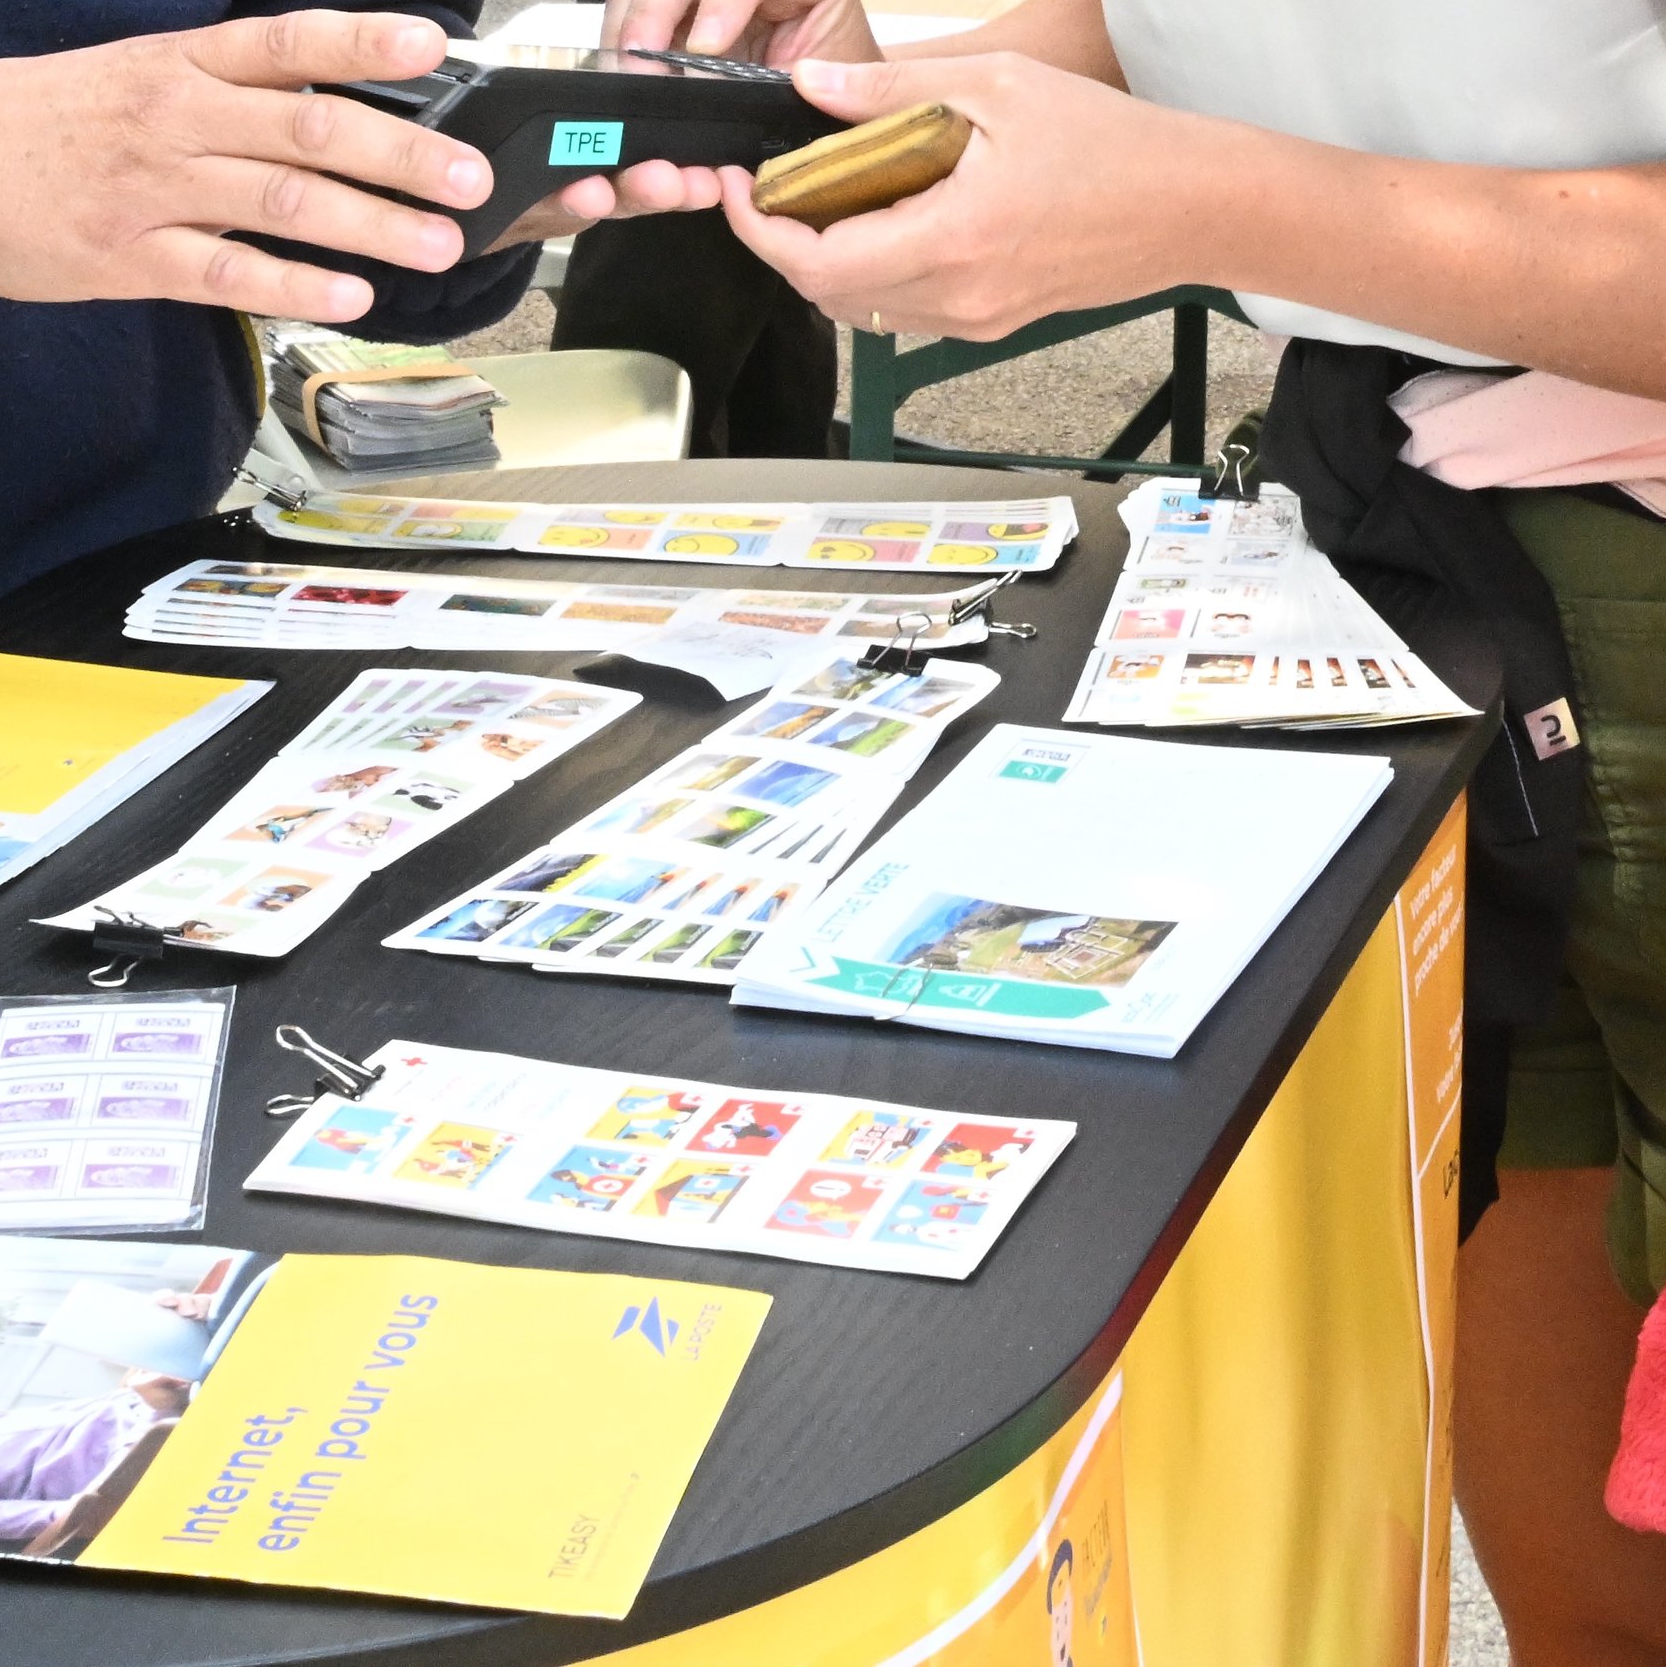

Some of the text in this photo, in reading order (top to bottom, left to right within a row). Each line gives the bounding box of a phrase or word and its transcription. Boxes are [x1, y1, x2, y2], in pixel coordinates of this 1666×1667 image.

[565, 131, 607, 154] TPE
[811, 862, 910, 943] LETTRE VERTE
[684, 1302, 722, 1362] LA POSTE
[257, 1293, 439, 1551] enfin pour vous
[162, 1406, 309, 1544] Internet,
[548, 1514, 601, 1580] TIKEASY
